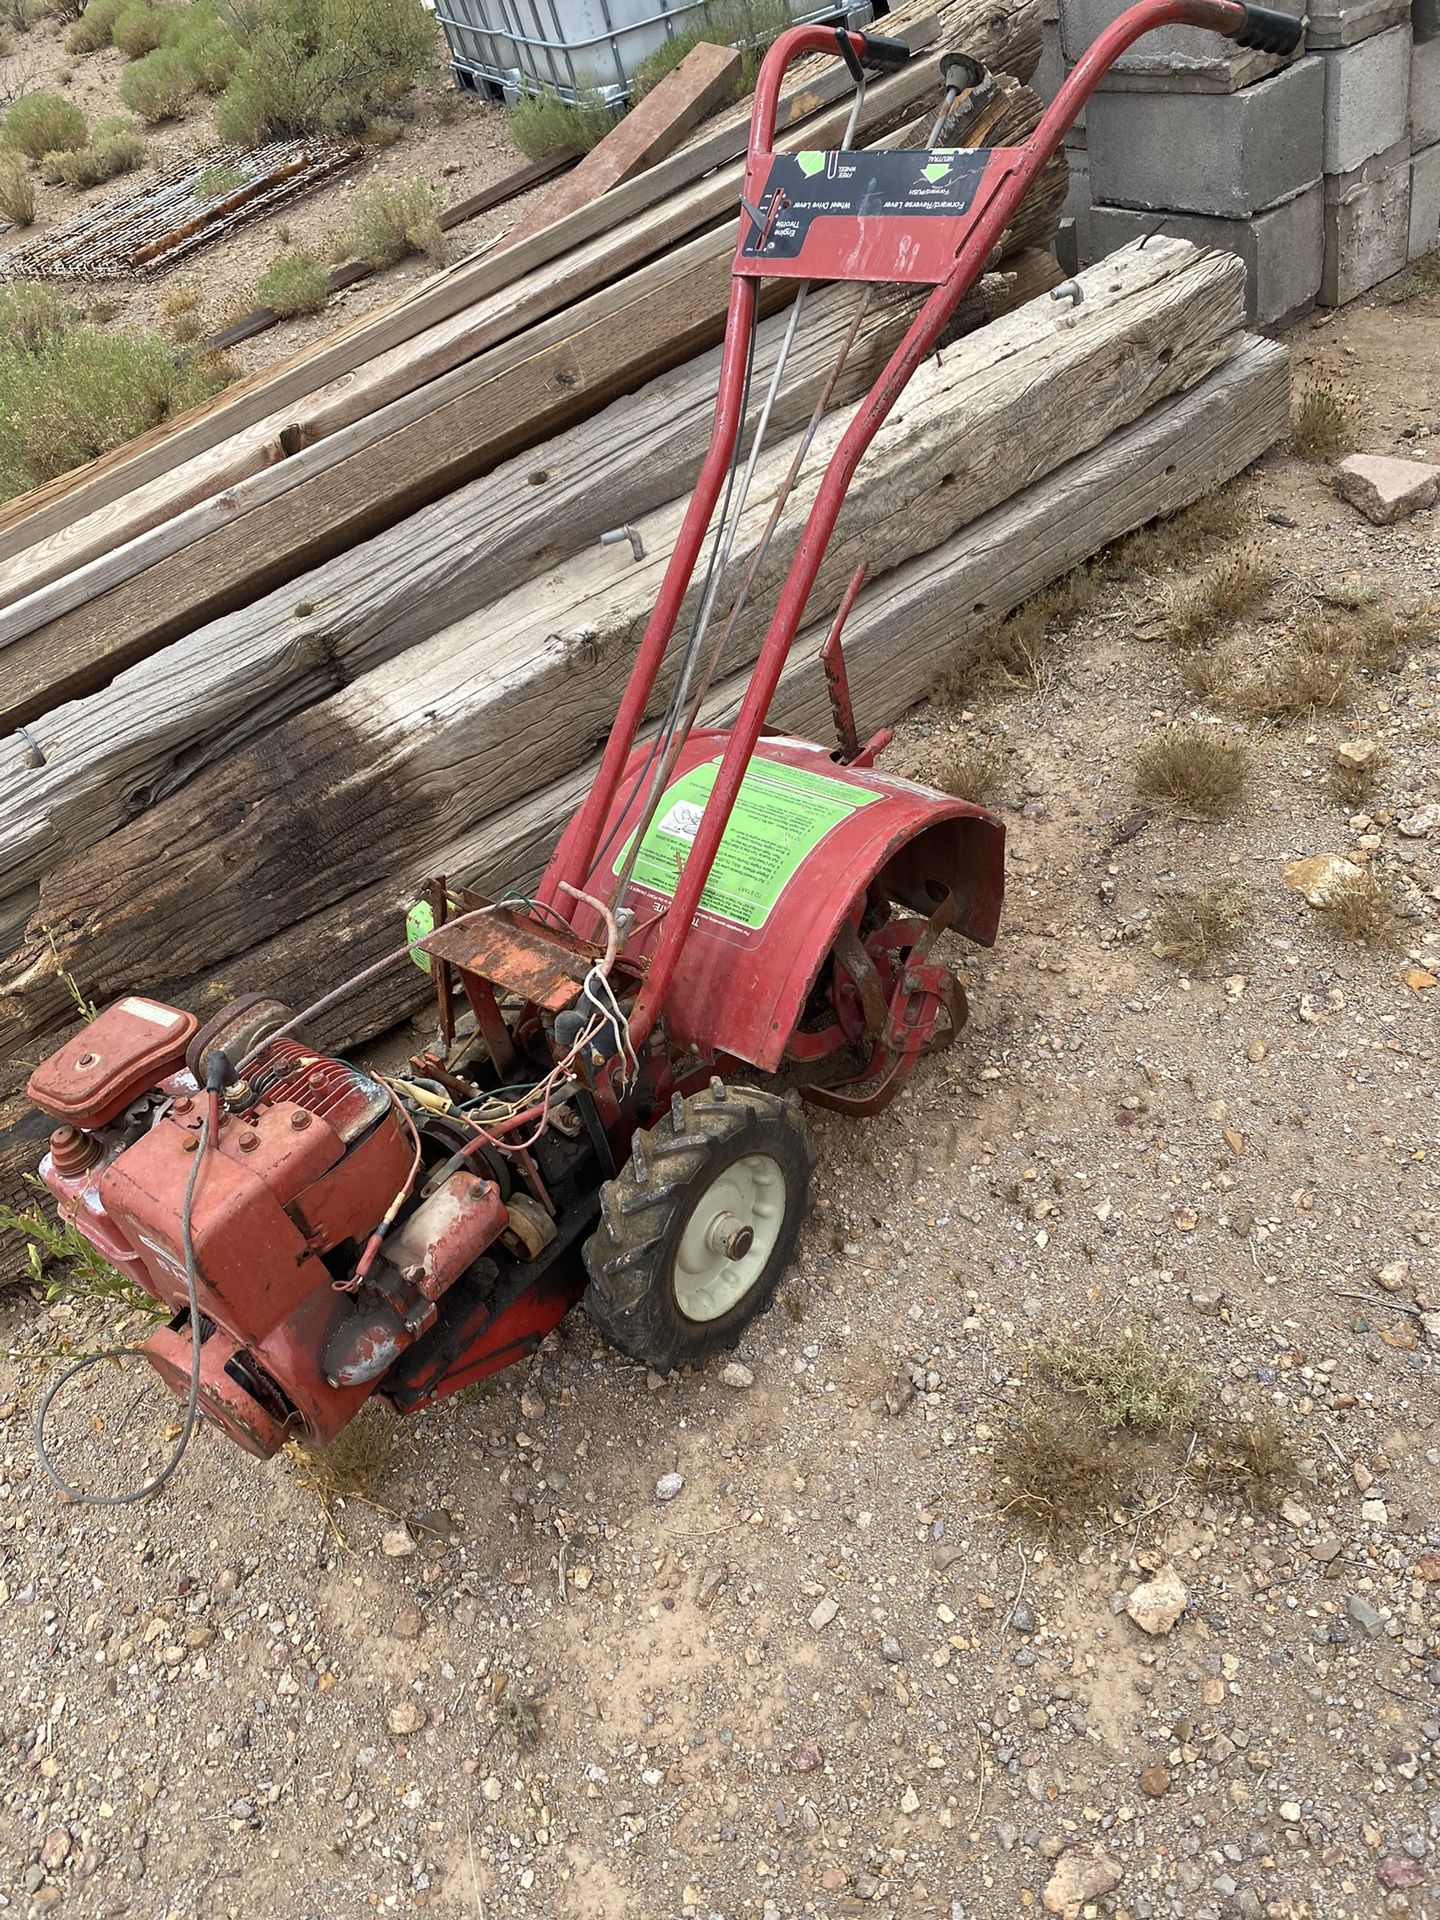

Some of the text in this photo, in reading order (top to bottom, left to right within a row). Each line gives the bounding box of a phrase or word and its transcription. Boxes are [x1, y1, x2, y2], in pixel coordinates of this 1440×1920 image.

[793, 201, 851, 210] Wheel Drive Lever
[883, 201, 965, 210] Forward/Reverse Lever
[775, 221, 800, 229] Throttle
[773, 227, 796, 237] Engine
